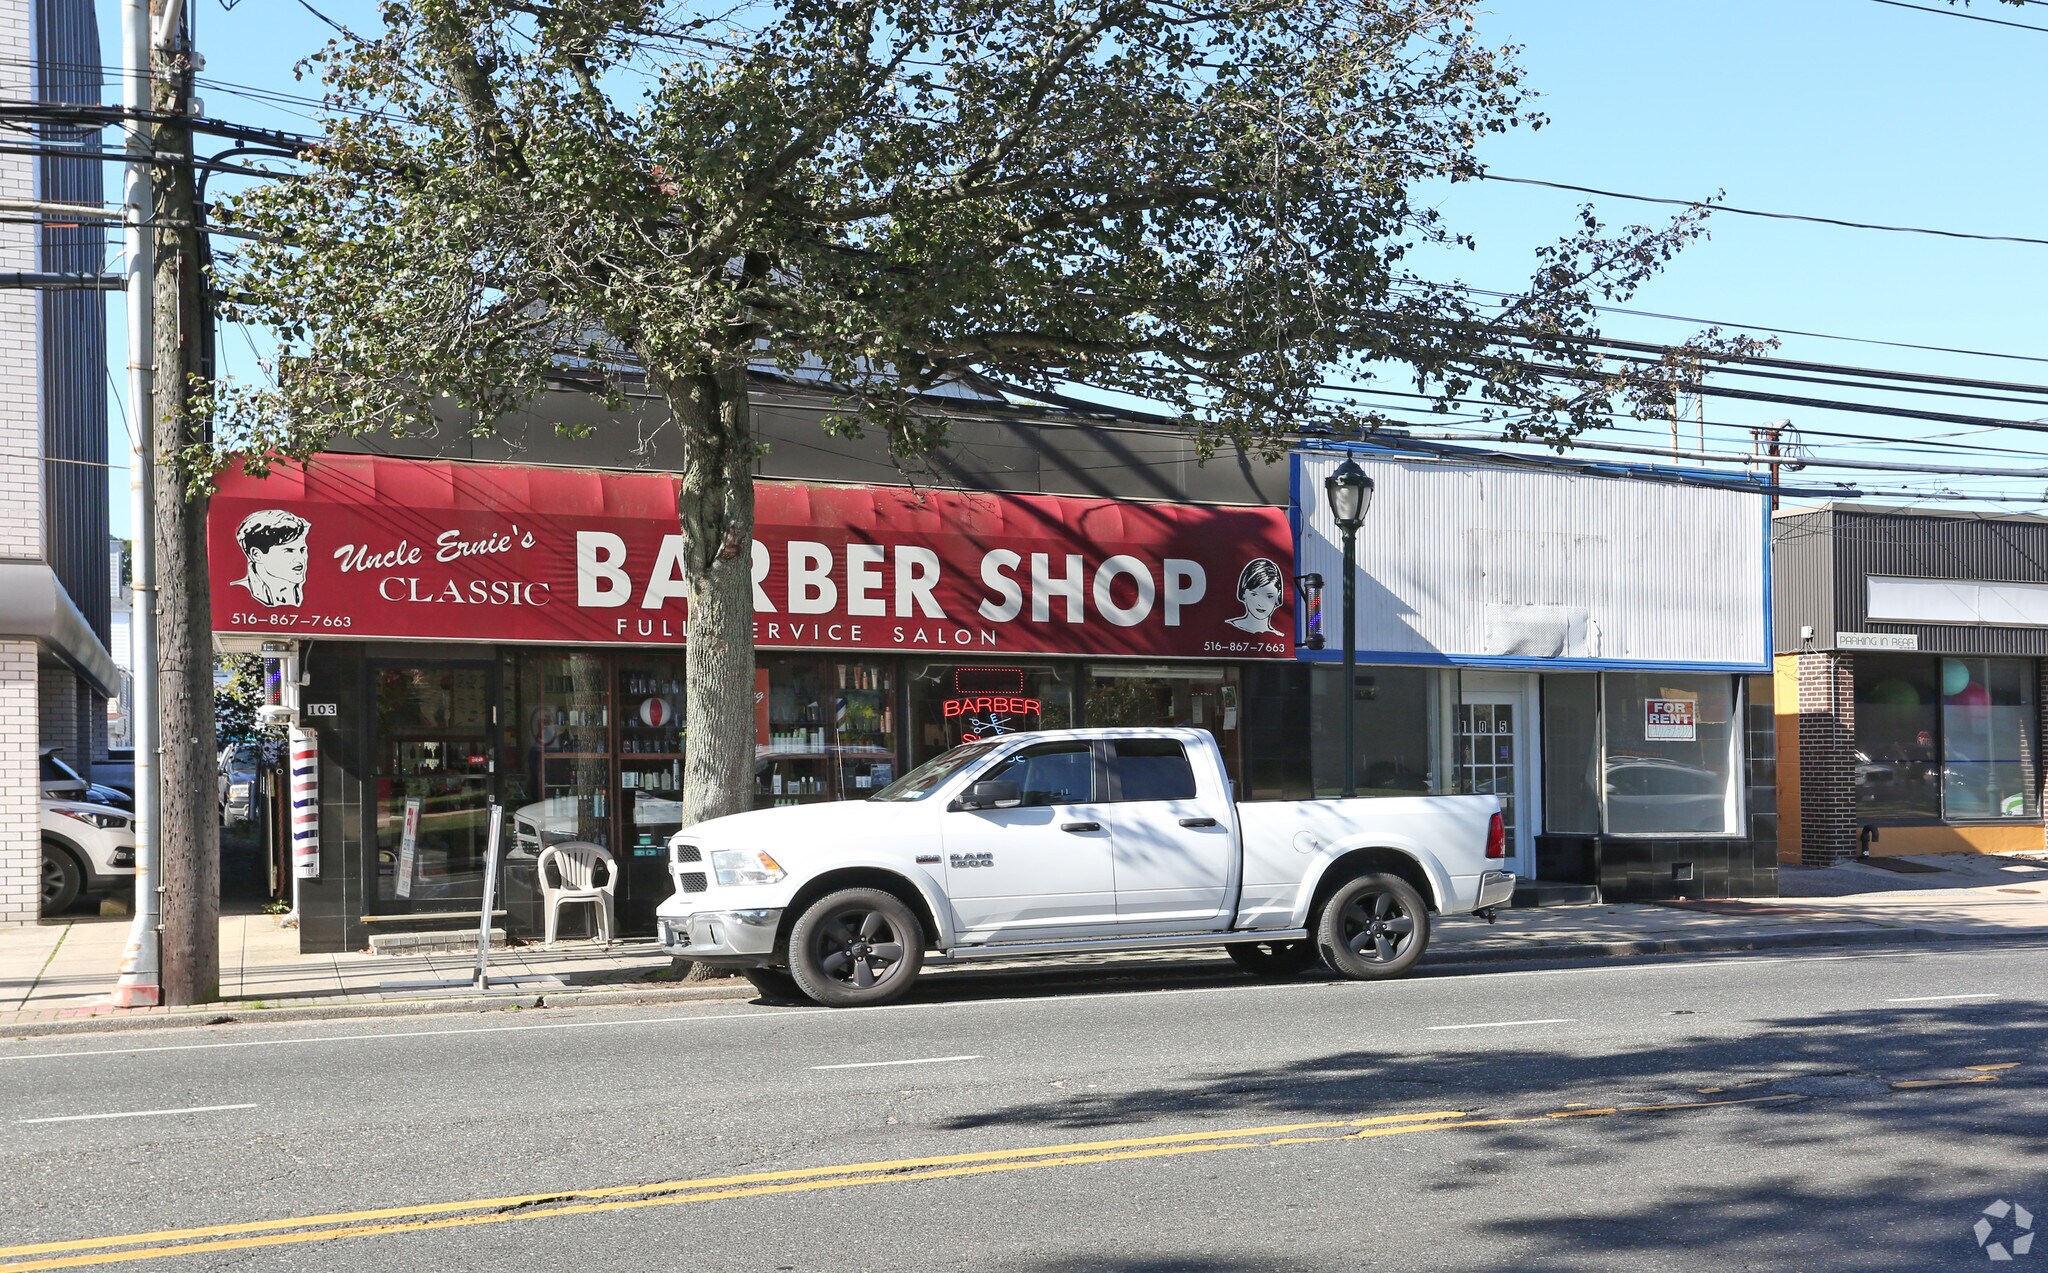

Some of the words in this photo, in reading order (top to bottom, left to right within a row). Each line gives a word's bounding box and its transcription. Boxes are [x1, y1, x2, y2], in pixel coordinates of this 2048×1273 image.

[333, 539, 423, 573] Uncle
[435, 524, 536, 563] Ernie's
[378, 576, 550, 606] CLASSIC
[977, 548, 1207, 627] SHOP
[231, 612, 351, 628] 516-867-7663
[893, 626, 996, 646] SALON
[1839, 635, 1878, 646] PARKING
[1891, 637, 1916, 647] REAR
[1203, 641, 1286, 653] 516-867-7663
[309, 704, 336, 715] 103
[943, 696, 1041, 717] BARBER
[1653, 702, 1686, 713] FOR
[1649, 713, 1692, 724] RENT
[950, 852, 994, 861] RAM
[951, 860, 994, 869] 1500
